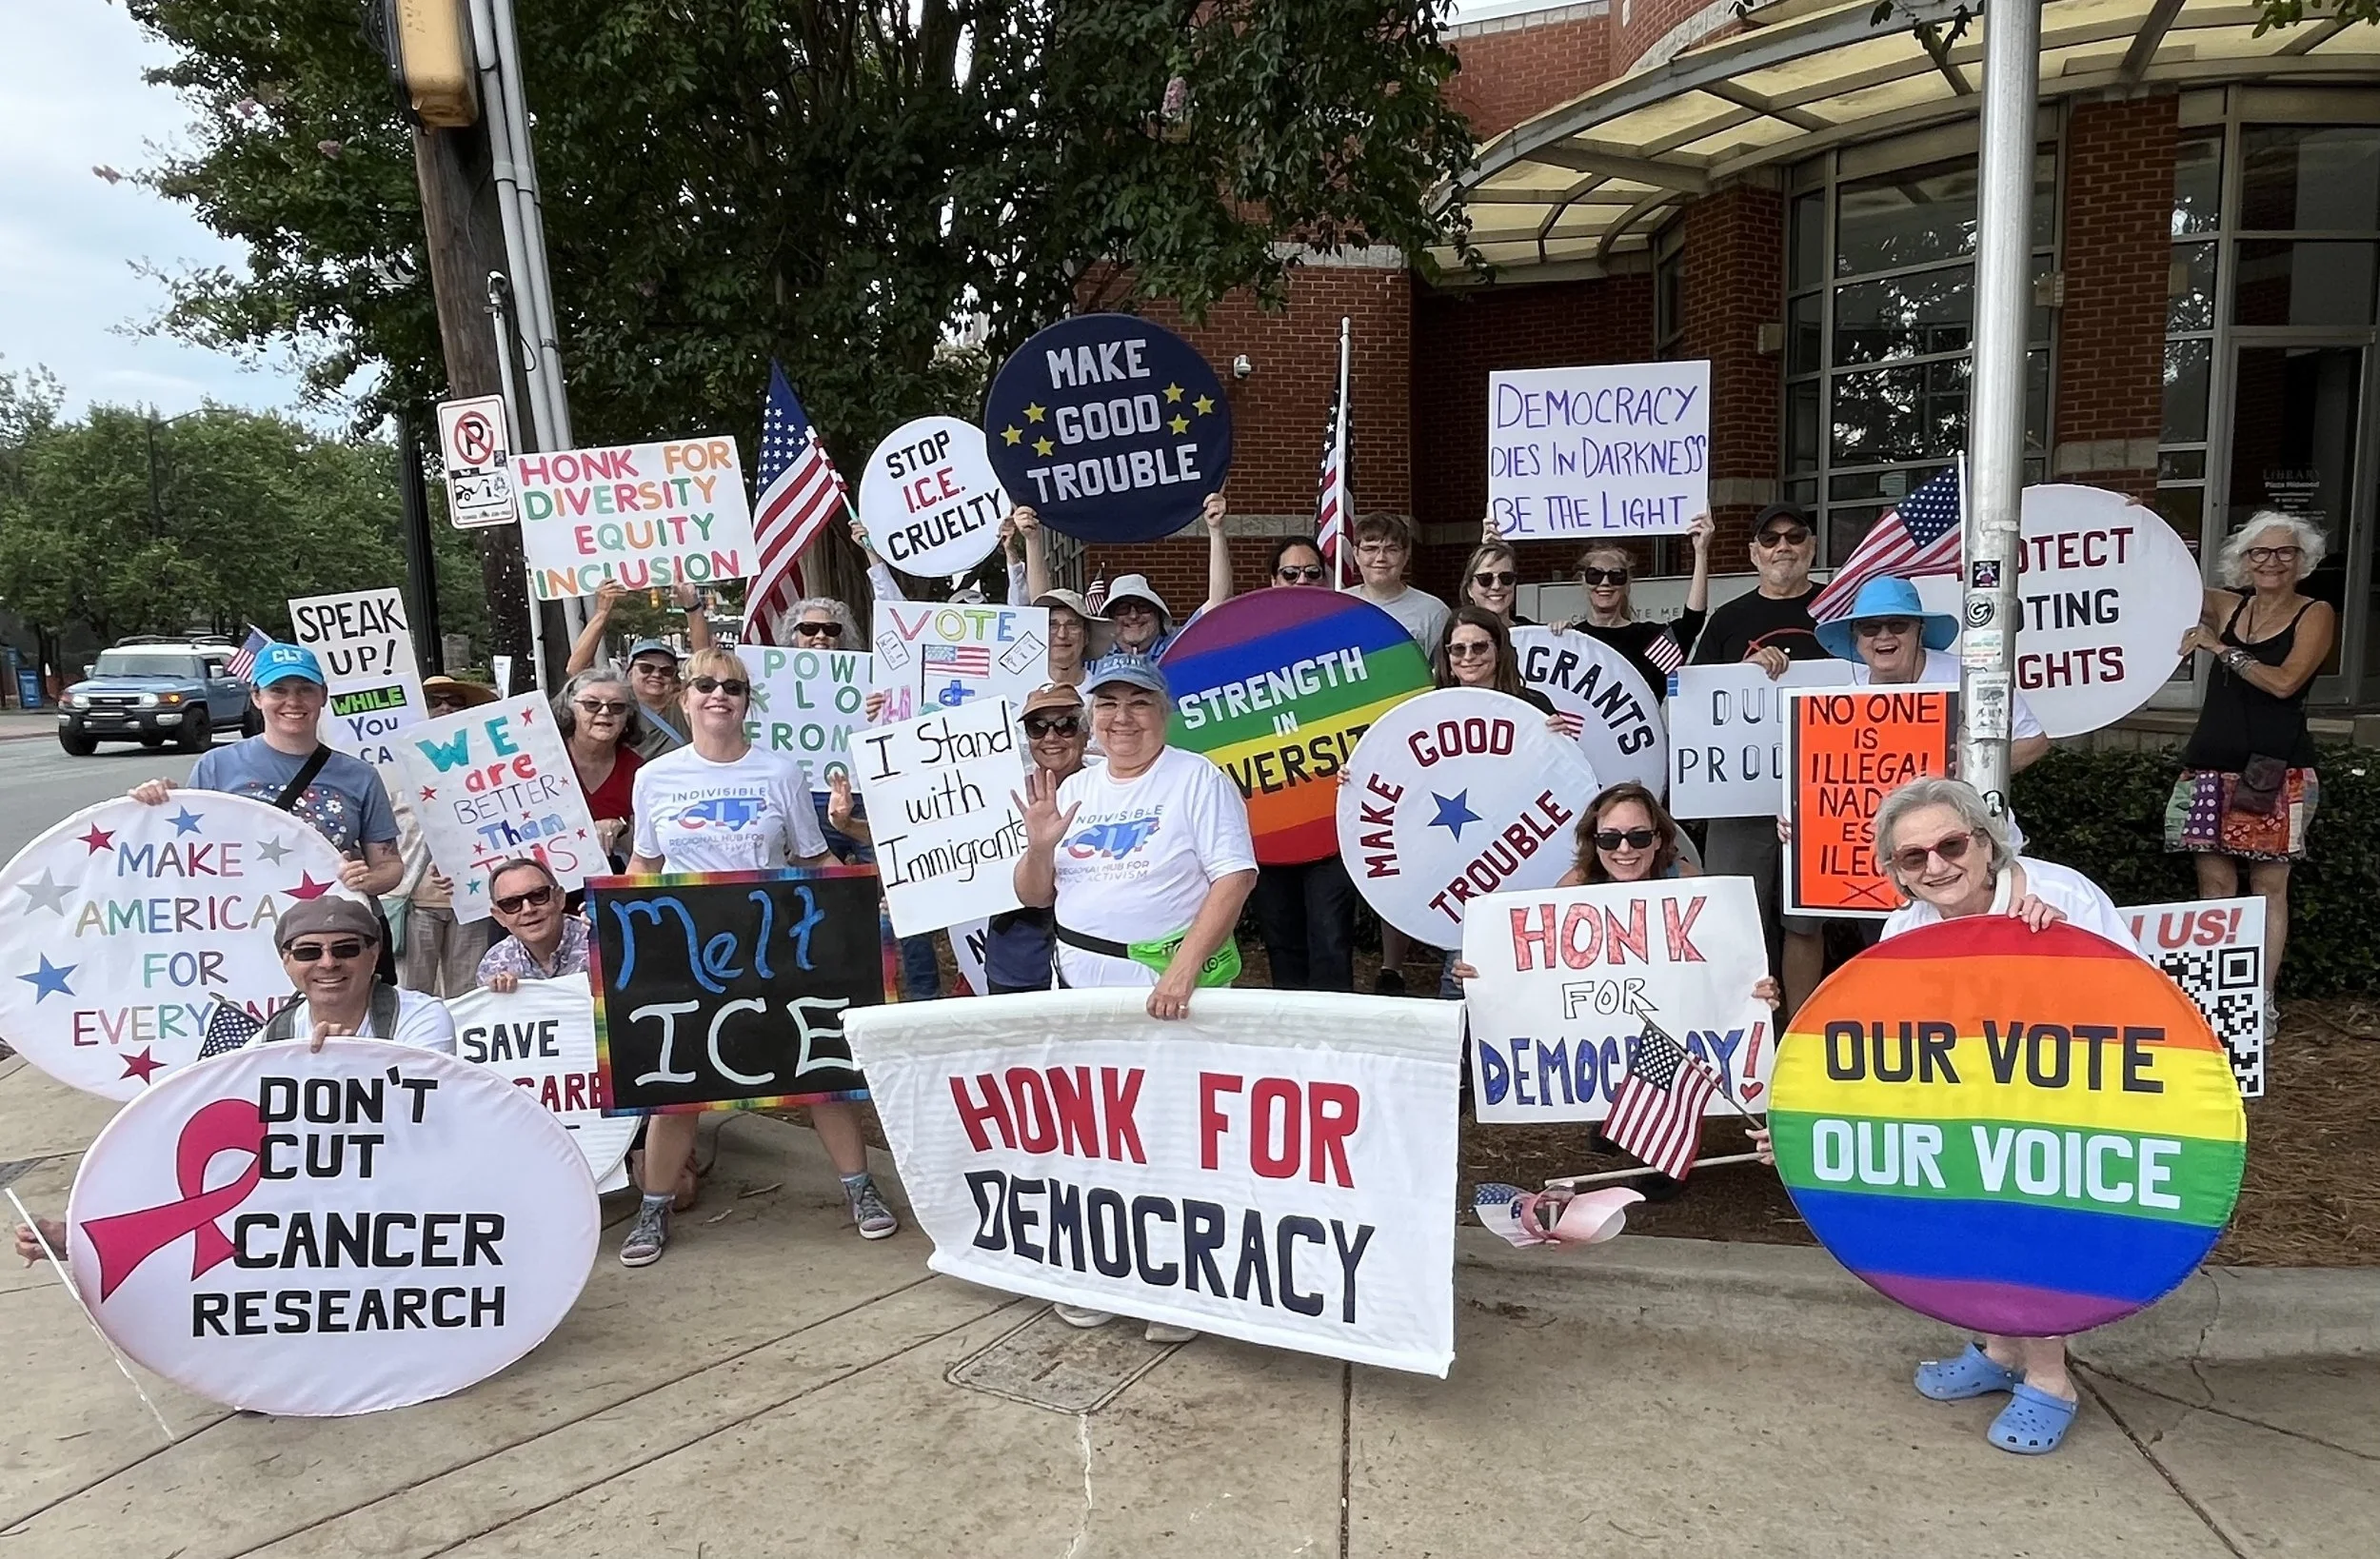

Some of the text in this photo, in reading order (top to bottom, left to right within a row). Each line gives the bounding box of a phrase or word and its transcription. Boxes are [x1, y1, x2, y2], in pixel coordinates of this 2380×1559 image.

[1046, 339, 1151, 389] MAKE
[1056, 395, 1161, 445] GOOD
[1497, 383, 1697, 428] DEMOCRACY
[518, 441, 732, 486] HONK FOR
[885, 429, 951, 479] STOP
[1026, 443, 1201, 503] TROUBLE
[1491, 434, 1705, 478] DIES IN DARKNESS
[524, 475, 716, 521] DIVERSITY
[902, 466, 966, 514] I.C.E.
[1492, 491, 1688, 534] BE THE LIGHT
[574, 512, 715, 555] EQUITY
[887, 487, 1002, 561] CRUELTY
[296, 598, 407, 642] SPEAK
[888, 607, 1016, 642] VOTE
[271, 648, 303, 662] CLT
[327, 639, 396, 676] UP!
[764, 649, 873, 684] POW
[2015, 646, 2125, 689] GHTS
[330, 685, 407, 716] WHILE
[1178, 646, 1368, 730] STRENGTH
[1810, 692, 1939, 725] NO ONE
[415, 716, 520, 773] WE
[865, 733, 901, 780] I
[918, 701, 1013, 764] Stand
[1272, 711, 1299, 738] IN
[1408, 718, 1515, 768] GOOD
[1854, 727, 1878, 749] IS
[465, 754, 537, 793] are
[672, 787, 765, 802] INDIVISIBLE
[453, 774, 560, 824] BETTER
[678, 799, 759, 829] CLT
[905, 769, 985, 824] with
[1076, 804, 1163, 824] NDIVISIBLE
[1819, 787, 1885, 819] NAD
[477, 813, 566, 850] Than
[722, 834, 743, 843] HUB
[1067, 821, 1149, 859] CLT
[1359, 773, 1405, 878] MAKE
[1842, 822, 1875, 843] ES
[116, 841, 244, 878] MAKE
[469, 836, 579, 874] TIS
[878, 808, 1029, 889] Immigrants
[1101, 862, 1124, 871] HUB
[1126, 860, 1149, 870] FOR
[1428, 789, 1574, 924] TROUBLE
[74, 894, 278, 937] AMERICA
[1510, 896, 1707, 972] HONK
[2157, 907, 2244, 949] US!
[610, 885, 825, 994] Melt
[143, 950, 228, 989] FOR
[1561, 977, 1659, 1019] FOR
[73, 997, 293, 1047] EVERYN
[463, 1019, 559, 1064] SAVE
[628, 997, 854, 1086] ICE
[1824, 1020, 2166, 1094] OUR VOTE
[260, 1066, 438, 1124] DON'T
[949, 1065, 1360, 1189] HONK FOR
[260, 1133, 385, 1180] CUT
[1812, 1118, 2182, 1210] OUR VOICE
[233, 1212, 506, 1270] CANCER
[963, 1169, 1376, 1325] DEMOCRACY
[192, 1285, 506, 1337] RESEARCH
